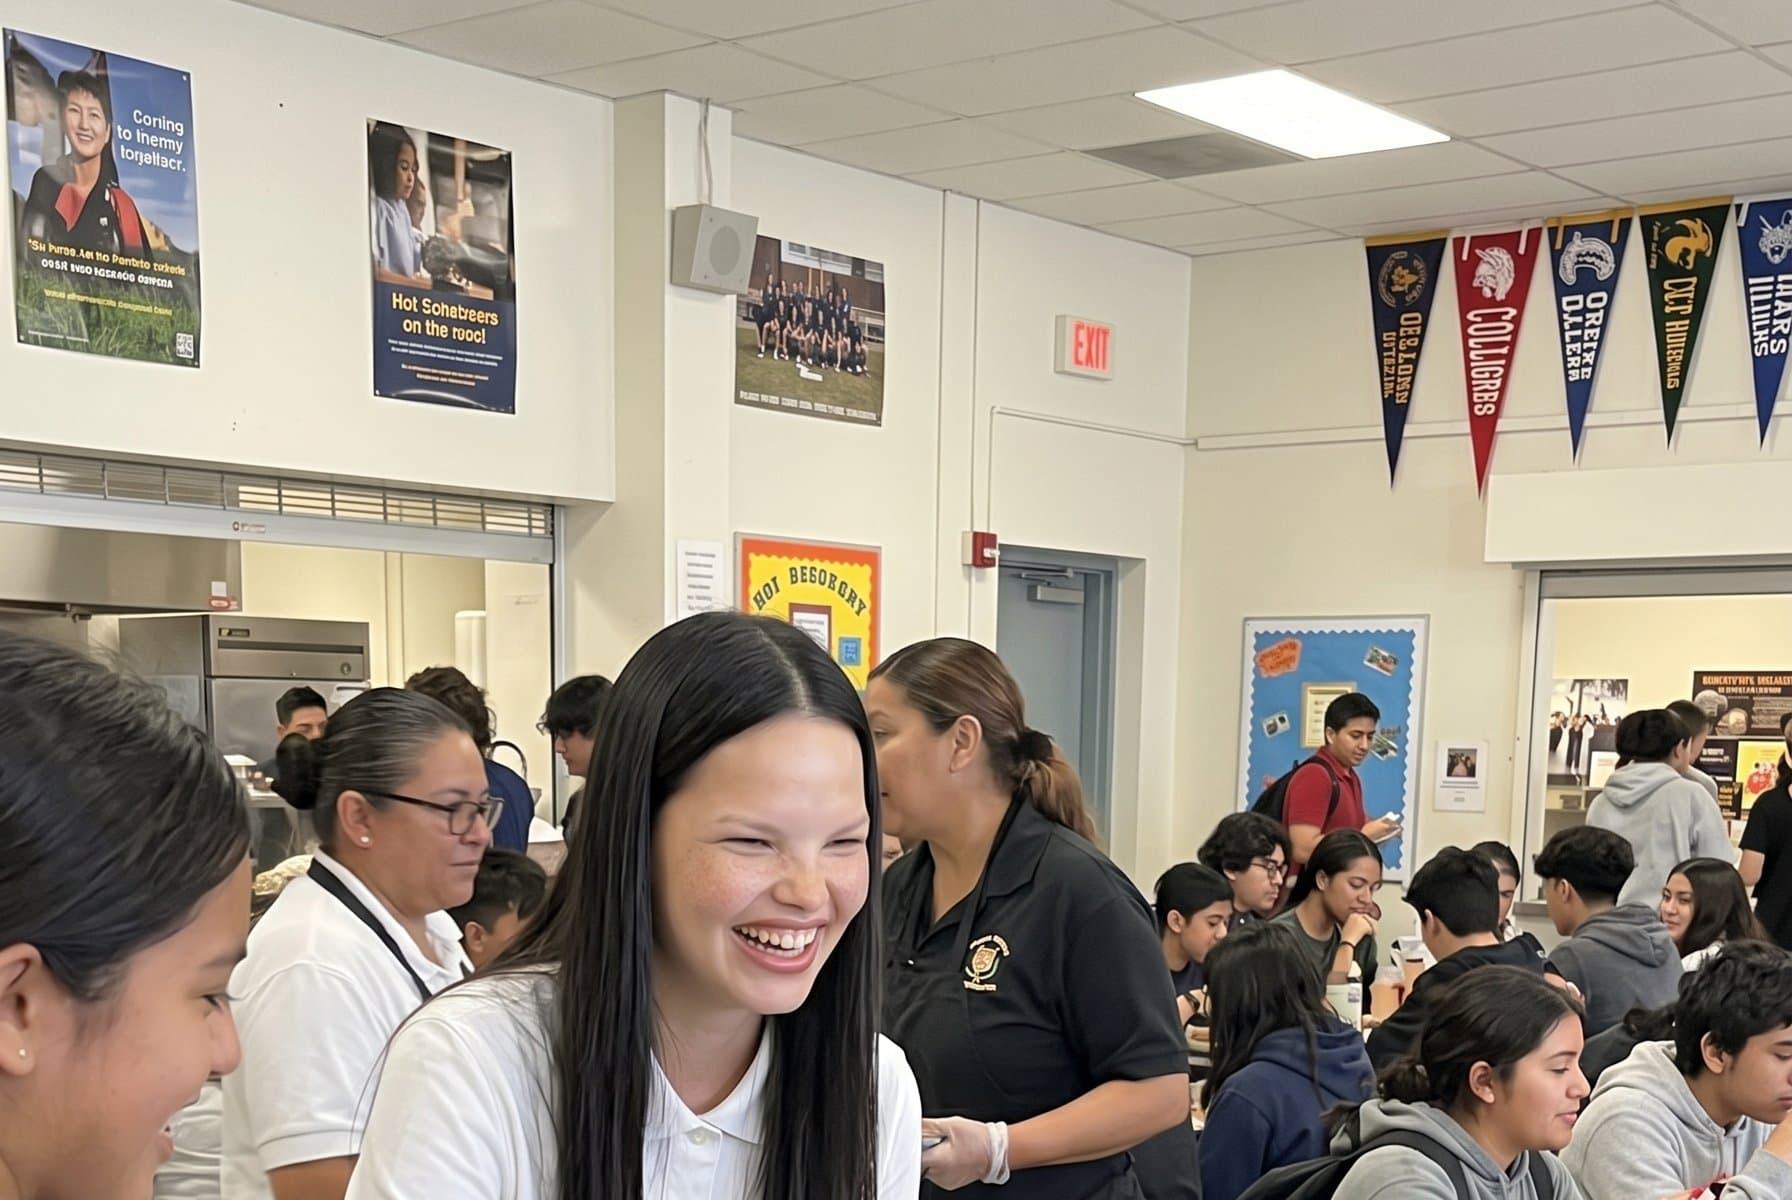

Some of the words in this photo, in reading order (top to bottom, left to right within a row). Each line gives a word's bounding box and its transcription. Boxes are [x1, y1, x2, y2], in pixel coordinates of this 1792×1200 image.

[117, 124, 132, 140] to
[391, 292, 418, 313] Hot
[402, 318, 422, 335] on
[425, 319, 449, 338] the
[1074, 320, 1110, 371] EXIT
